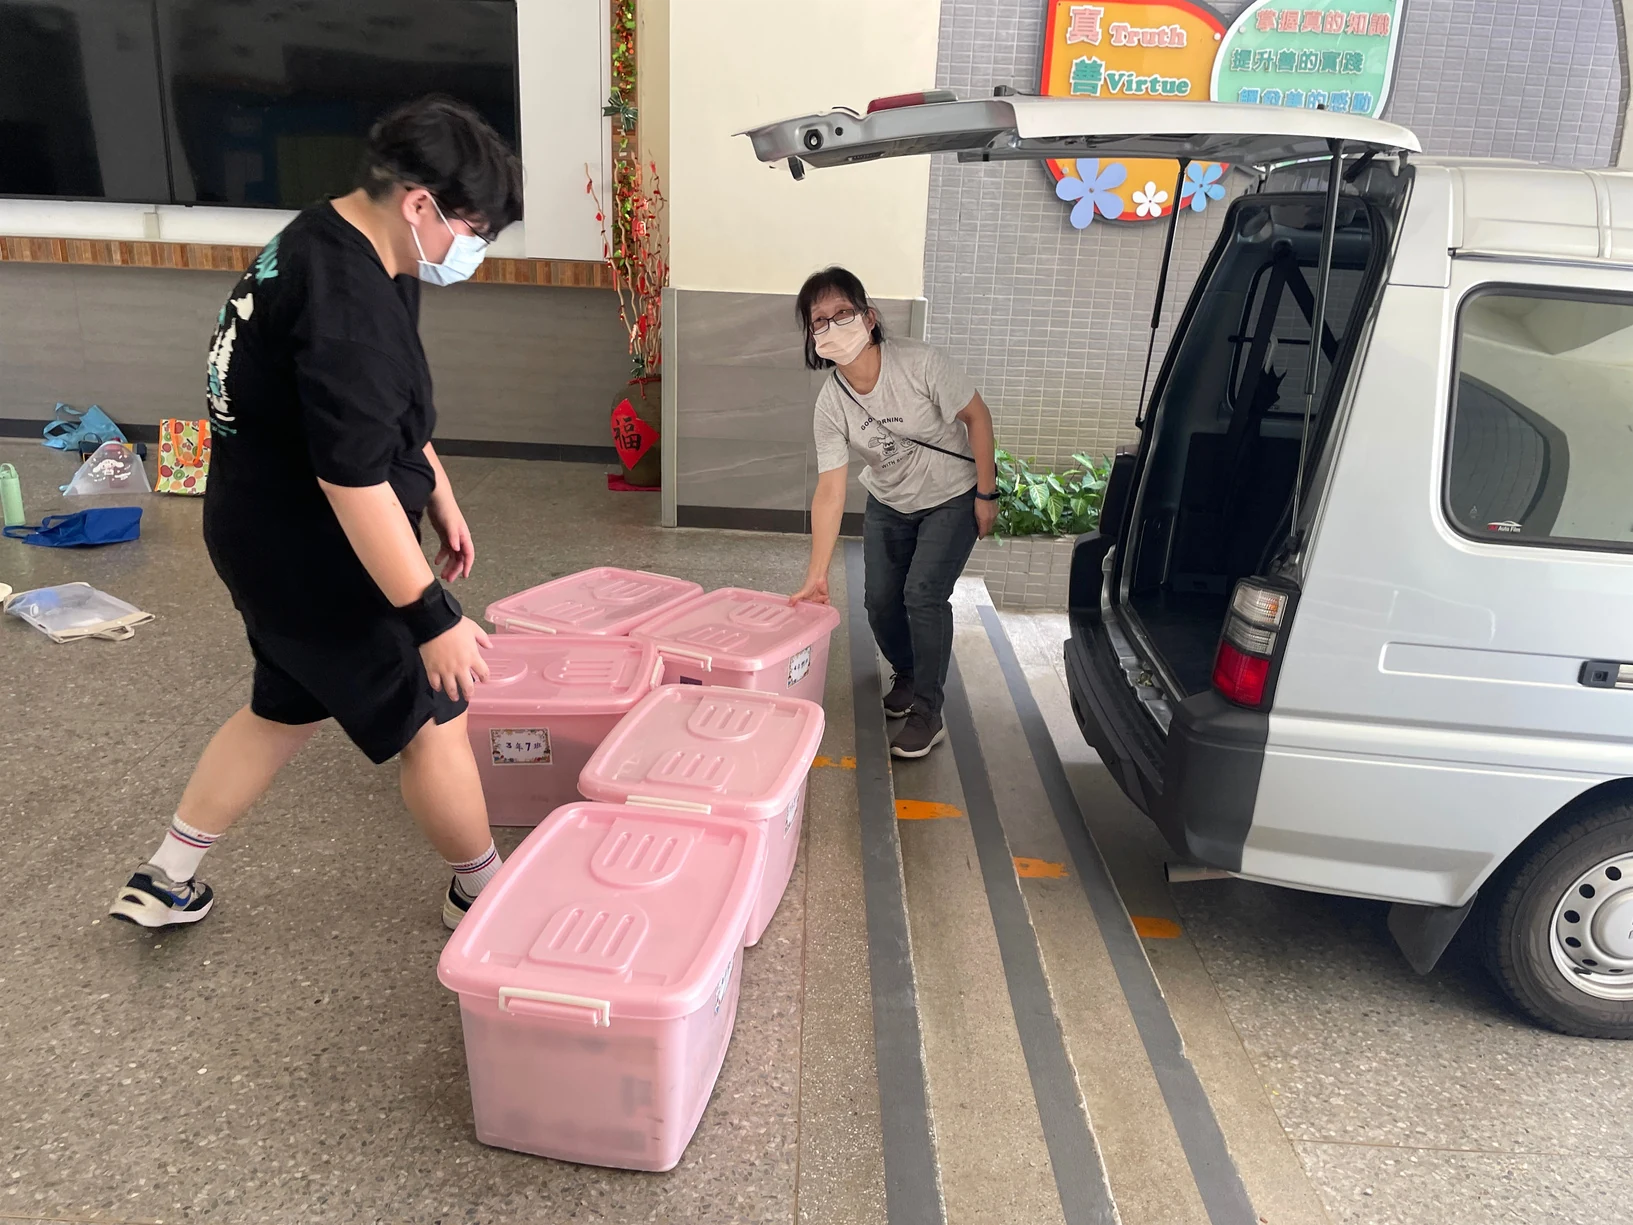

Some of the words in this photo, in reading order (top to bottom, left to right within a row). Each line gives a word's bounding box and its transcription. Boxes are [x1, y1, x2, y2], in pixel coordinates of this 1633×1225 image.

[1066, 5, 1104, 45] 真
[1109, 22, 1187, 47] Truth
[1256, 9, 1390, 36] 掌握真的知識
[1070, 56, 1105, 96] 善
[1105, 71, 1191, 94] Virtue
[1230, 48, 1365, 74] 提升善的實踐
[613, 417, 642, 451] 福
[861, 418, 875, 430] GOO
[877, 417, 904, 425] ORNING
